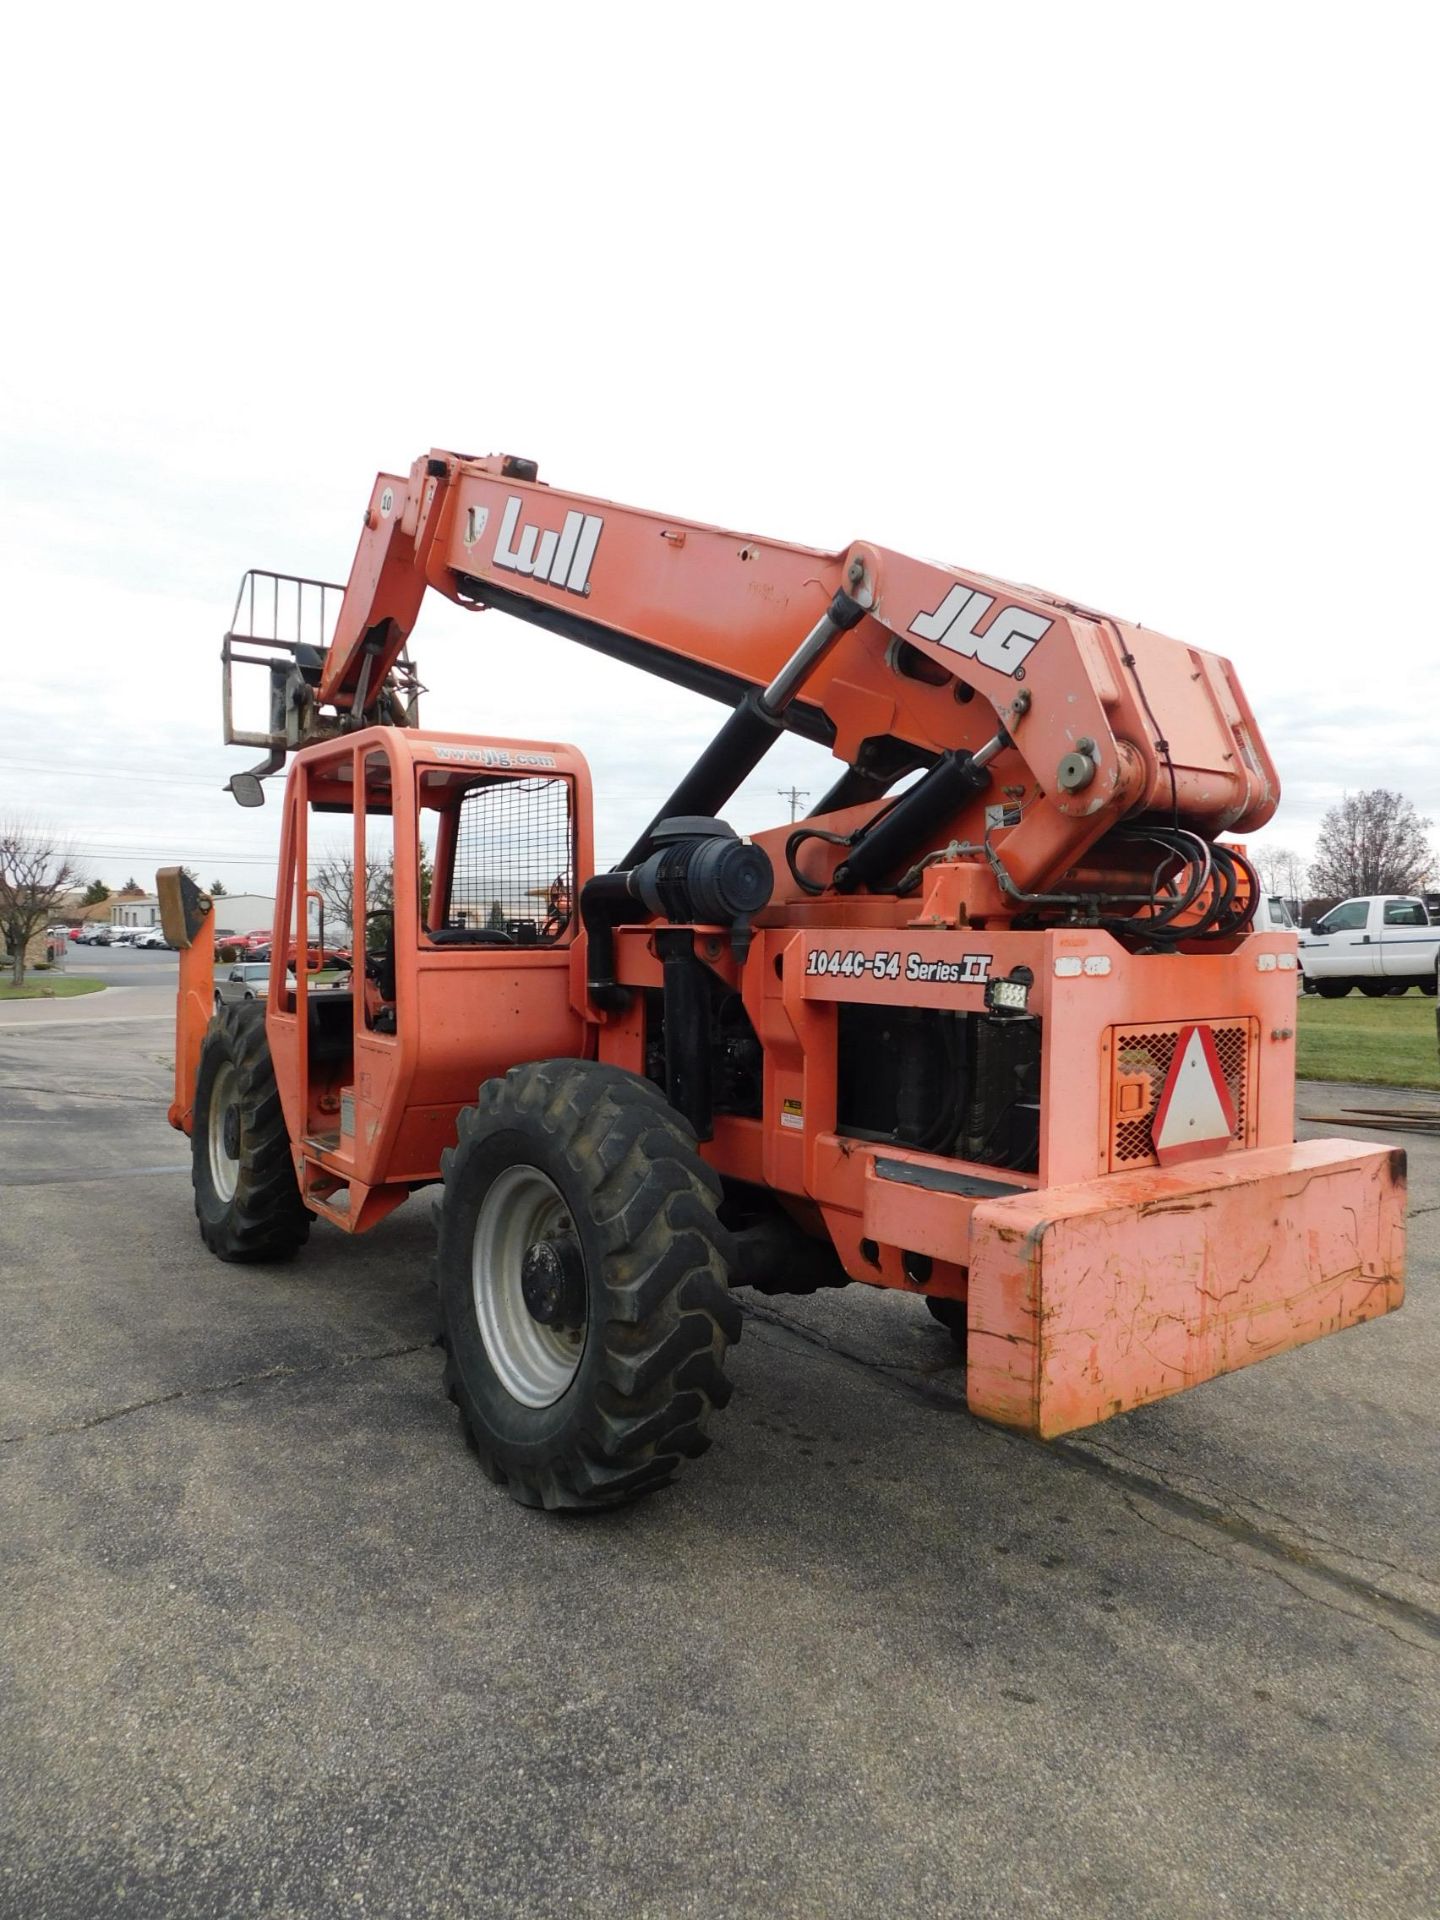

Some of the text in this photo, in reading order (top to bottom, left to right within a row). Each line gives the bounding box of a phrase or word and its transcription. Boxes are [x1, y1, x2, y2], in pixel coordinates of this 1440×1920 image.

[382, 495, 392, 511] 10
[907, 582, 1055, 677] JLG
[435, 748, 555, 766] www.jlg.com
[805, 950, 993, 984] 1044C-54 Series II
